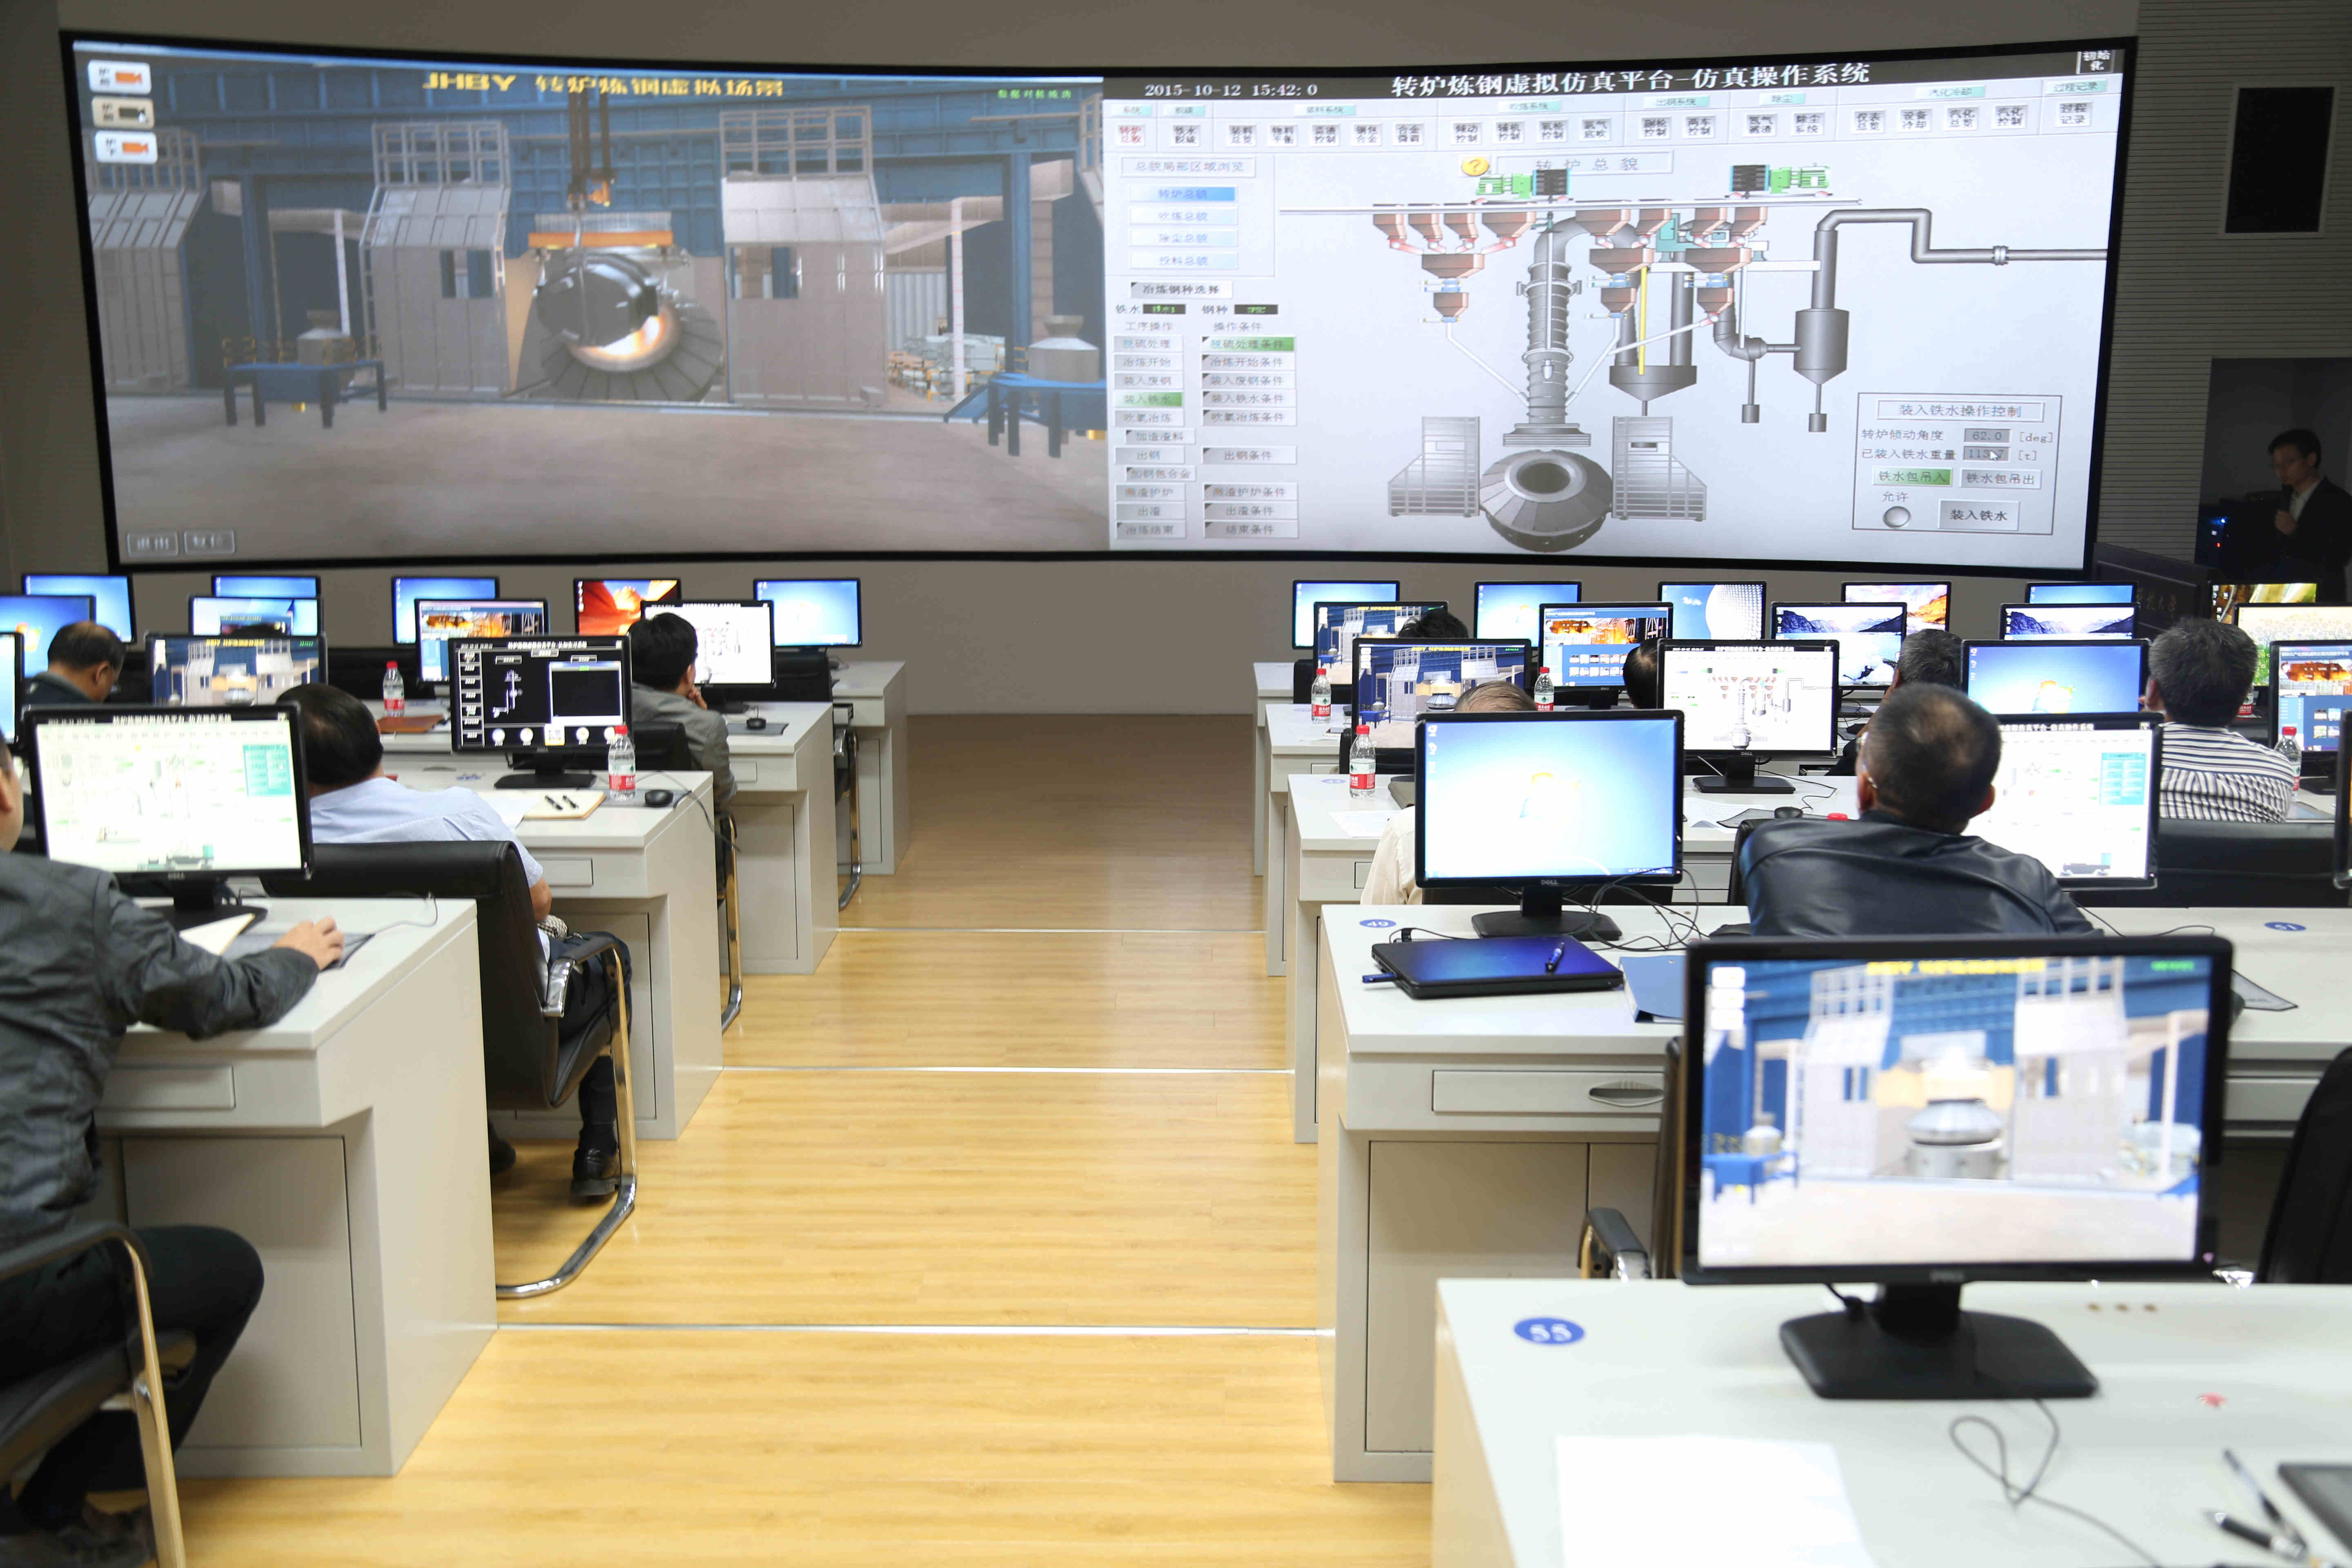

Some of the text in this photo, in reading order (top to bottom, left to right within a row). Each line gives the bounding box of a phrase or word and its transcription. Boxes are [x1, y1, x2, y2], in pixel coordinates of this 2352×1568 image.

[1392, 62, 1870, 97] 转炉炼钢虚拟仿真平台-仿真操作系统
[1145, 84, 1241, 97] 2015-10-12
[1899, 404, 2022, 418] 装入铁水操作控制
[1862, 429, 2054, 443] 转炉倾动角度 62.0 [deg]
[1862, 449, 1956, 460] 已装入铁水重量
[2018, 450, 2038, 461] [t]
[1879, 470, 1948, 483] 铁水包吊入
[1966, 473, 2035, 486] 铁水包吊出
[1882, 491, 1909, 503] 允许
[1950, 509, 2008, 521] 装入铁水
[1529, 1323, 1572, 1342] 55
